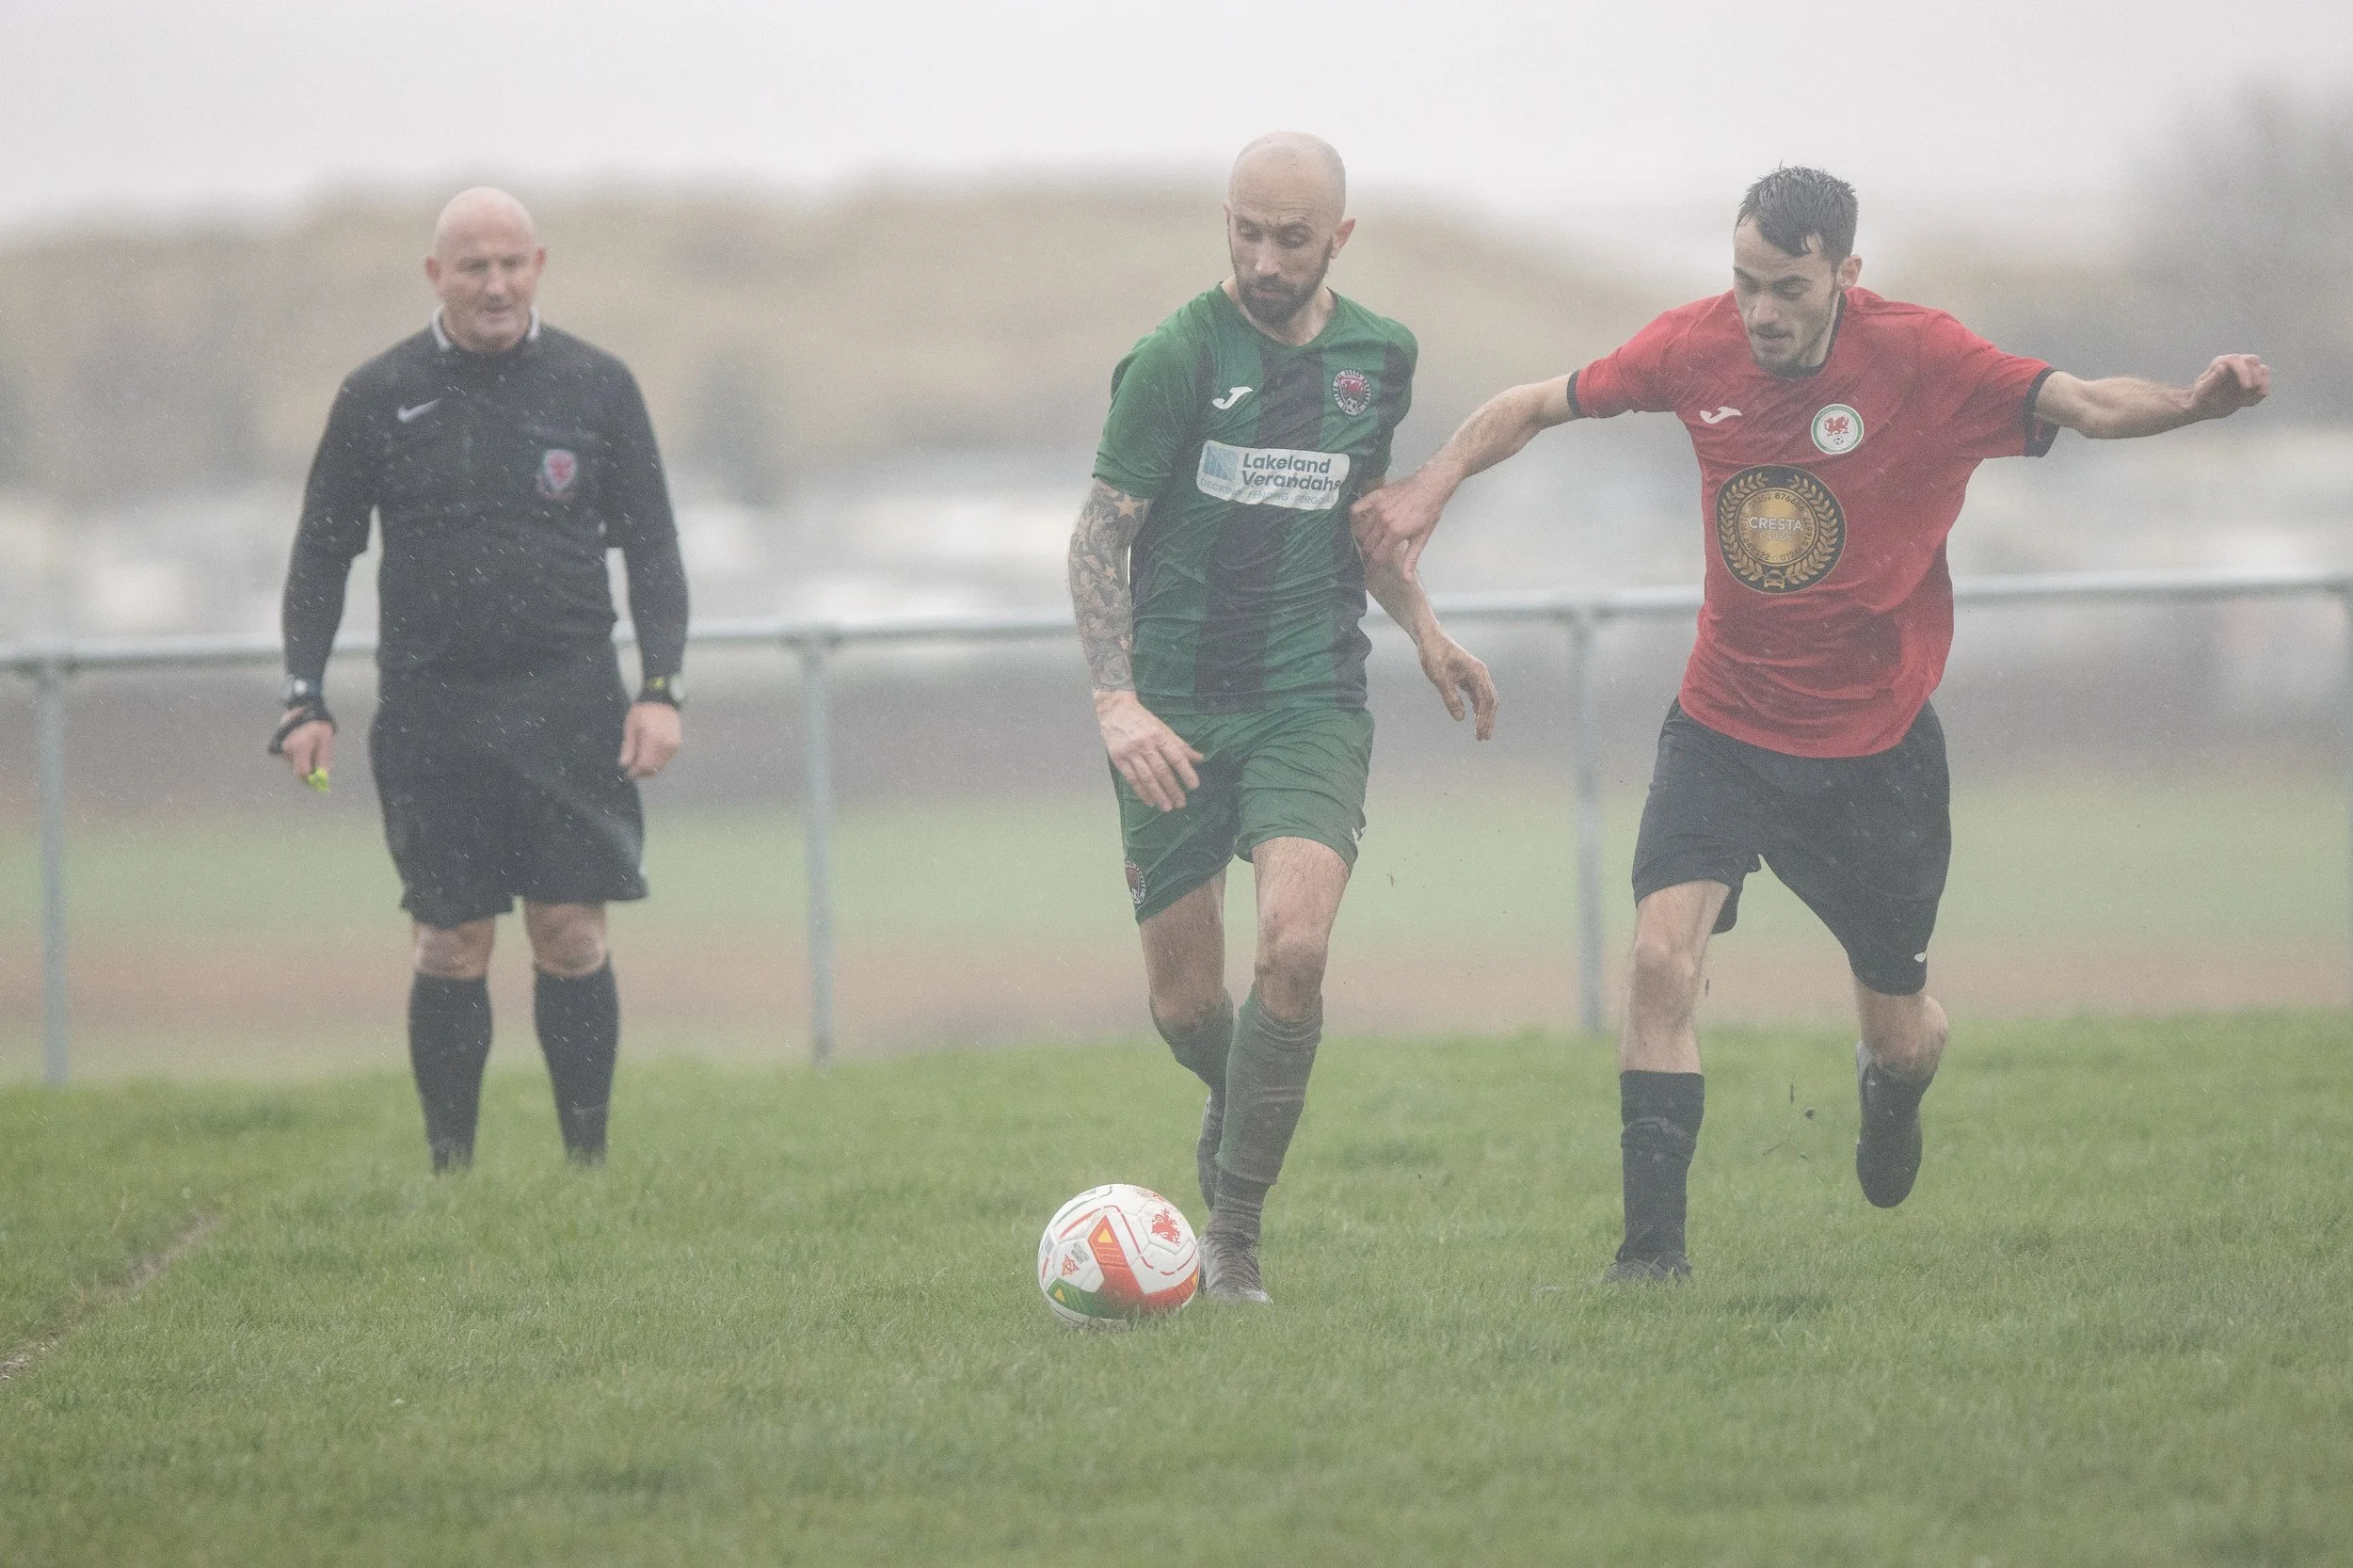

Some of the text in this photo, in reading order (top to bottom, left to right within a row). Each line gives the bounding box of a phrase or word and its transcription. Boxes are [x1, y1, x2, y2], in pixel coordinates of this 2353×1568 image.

[1242, 453, 1331, 473] Lakeland
[1774, 492, 1805, 511] 876666
[1749, 516, 1803, 531] CRESTA
[1759, 530, 1792, 542] CARS
